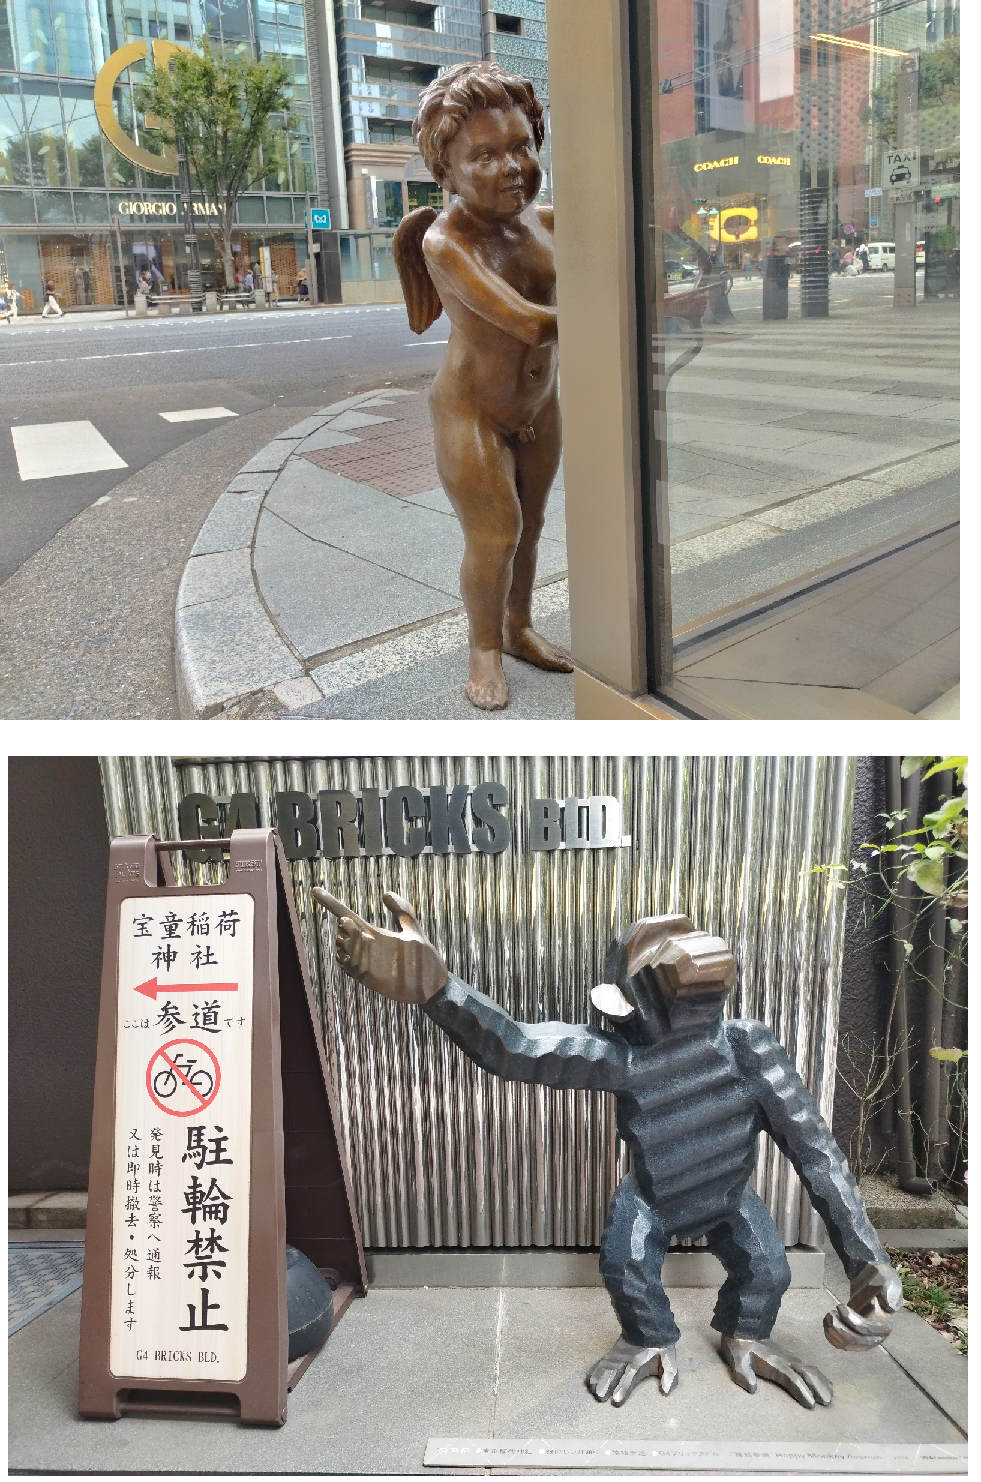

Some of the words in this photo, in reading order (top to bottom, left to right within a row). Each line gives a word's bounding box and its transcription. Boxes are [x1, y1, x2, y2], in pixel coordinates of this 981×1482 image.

[693, 156, 739, 172] COACH
[757, 155, 791, 166] COACH
[887, 151, 917, 165] TAXI
[117, 201, 177, 216] GIORGIO
[275, 782, 512, 860] BRICKS
[132, 910, 241, 940] 宝童稲荷
[151, 944, 218, 972] 神社
[146, 1127, 164, 1280] 発見時は警察へ通報
[179, 1125, 234, 1332] 駐輪禁止
[136, 1349, 149, 1361] G4
[154, 1350, 192, 1362] BRICKS
[198, 1351, 220, 1363] BLD.
